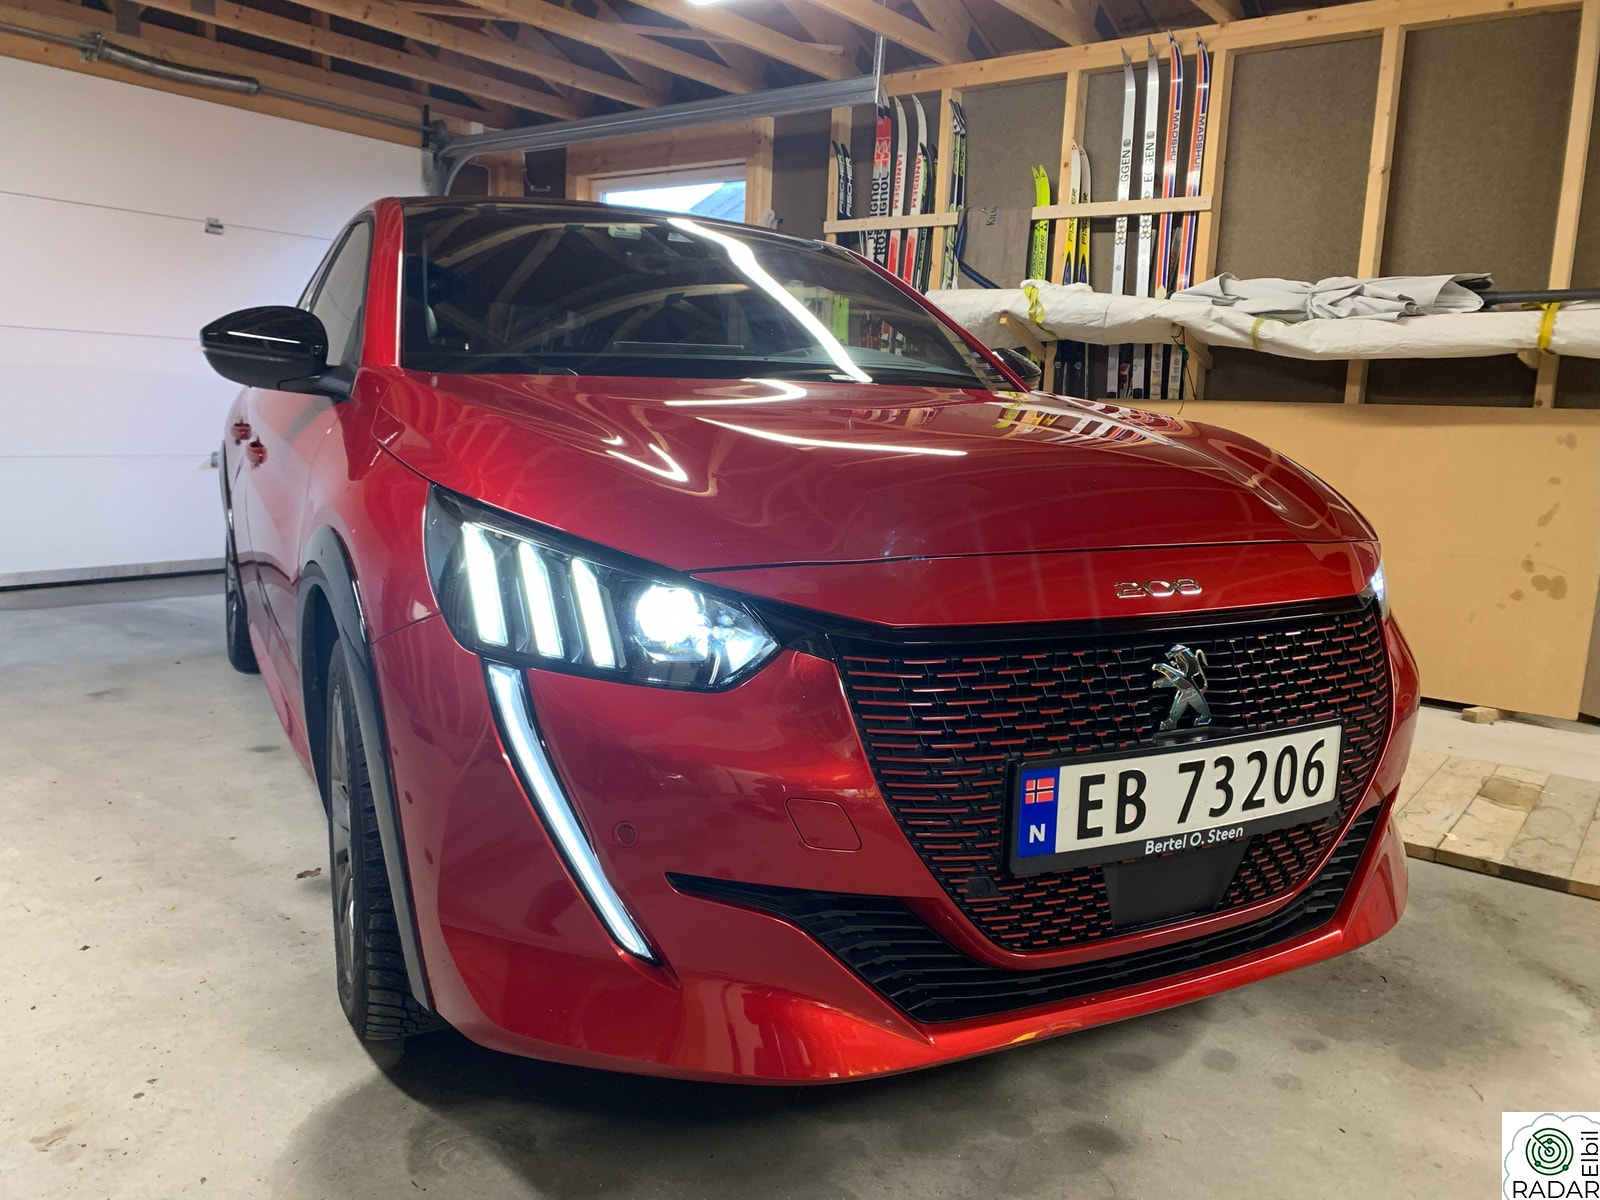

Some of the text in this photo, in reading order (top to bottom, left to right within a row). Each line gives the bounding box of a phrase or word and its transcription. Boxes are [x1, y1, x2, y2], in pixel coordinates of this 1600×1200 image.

[1170, 112, 1180, 167] MADSHU
[837, 153, 845, 214] FISCHER
[845, 156, 853, 217] FISCHER
[893, 154, 903, 210] LANDSEM
[1120, 149, 1131, 188] GGEN
[867, 172, 881, 250] SIGNOL
[876, 171, 889, 254] ROSIGNOL
[1067, 188, 1078, 243] FISCER
[1081, 192, 1089, 245] FISCR
[1038, 233, 1046, 277] FISCHER
[1114, 578, 1202, 598] 208
[1076, 738, 1326, 840] EB 73206
[1028, 823, 1046, 844] N
[1145, 827, 1244, 855] Bertel O. Steen
